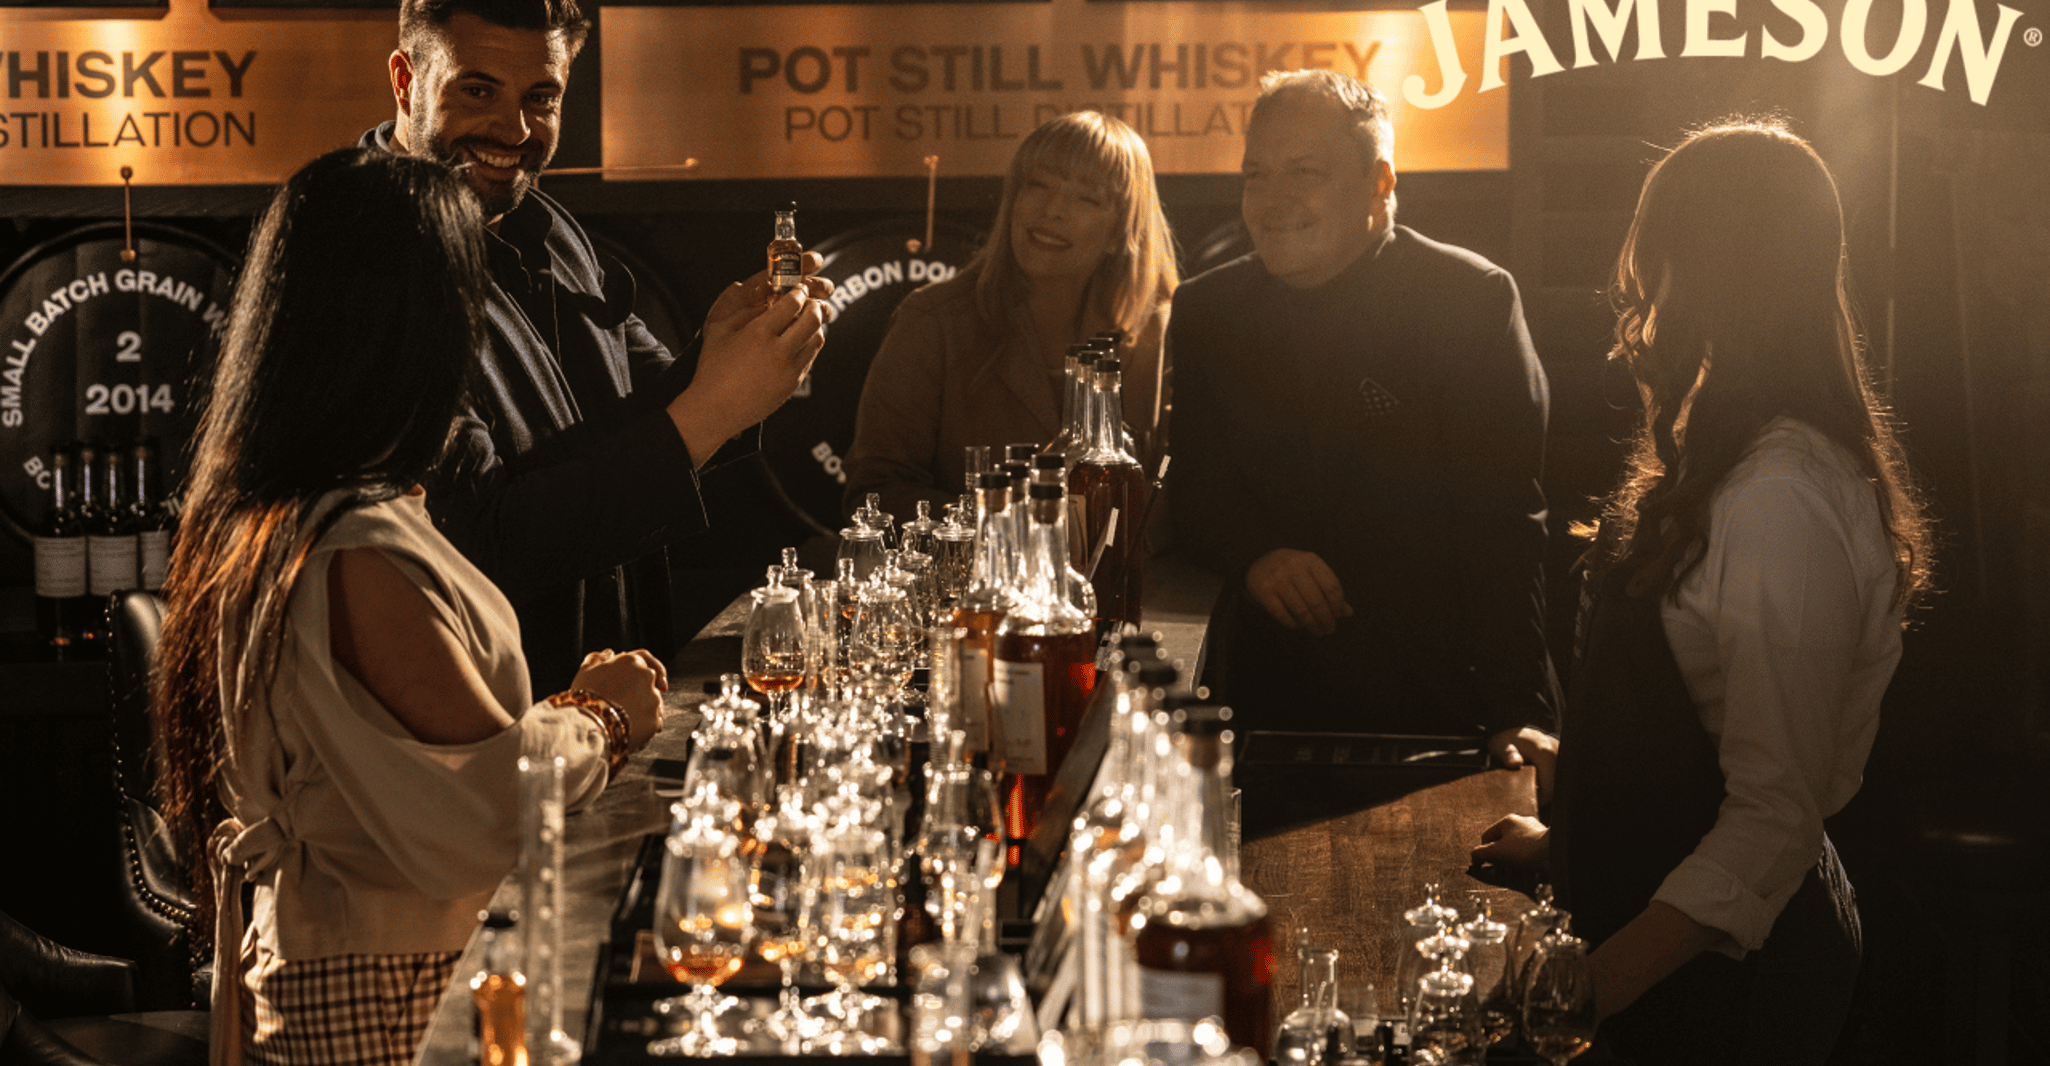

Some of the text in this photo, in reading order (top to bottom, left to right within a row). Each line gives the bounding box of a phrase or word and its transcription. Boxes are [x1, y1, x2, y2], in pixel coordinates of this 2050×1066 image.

[0, 51, 257, 98] HISKEY
[739, 46, 871, 94] POT
[890, 45, 1063, 94] STILL
[785, 105, 880, 142] POT
[895, 104, 1018, 141] STILL
[1, 268, 203, 427] SMALL BATCH GRAIN
[116, 331, 141, 362] 2
[86, 384, 174, 415] 2014
